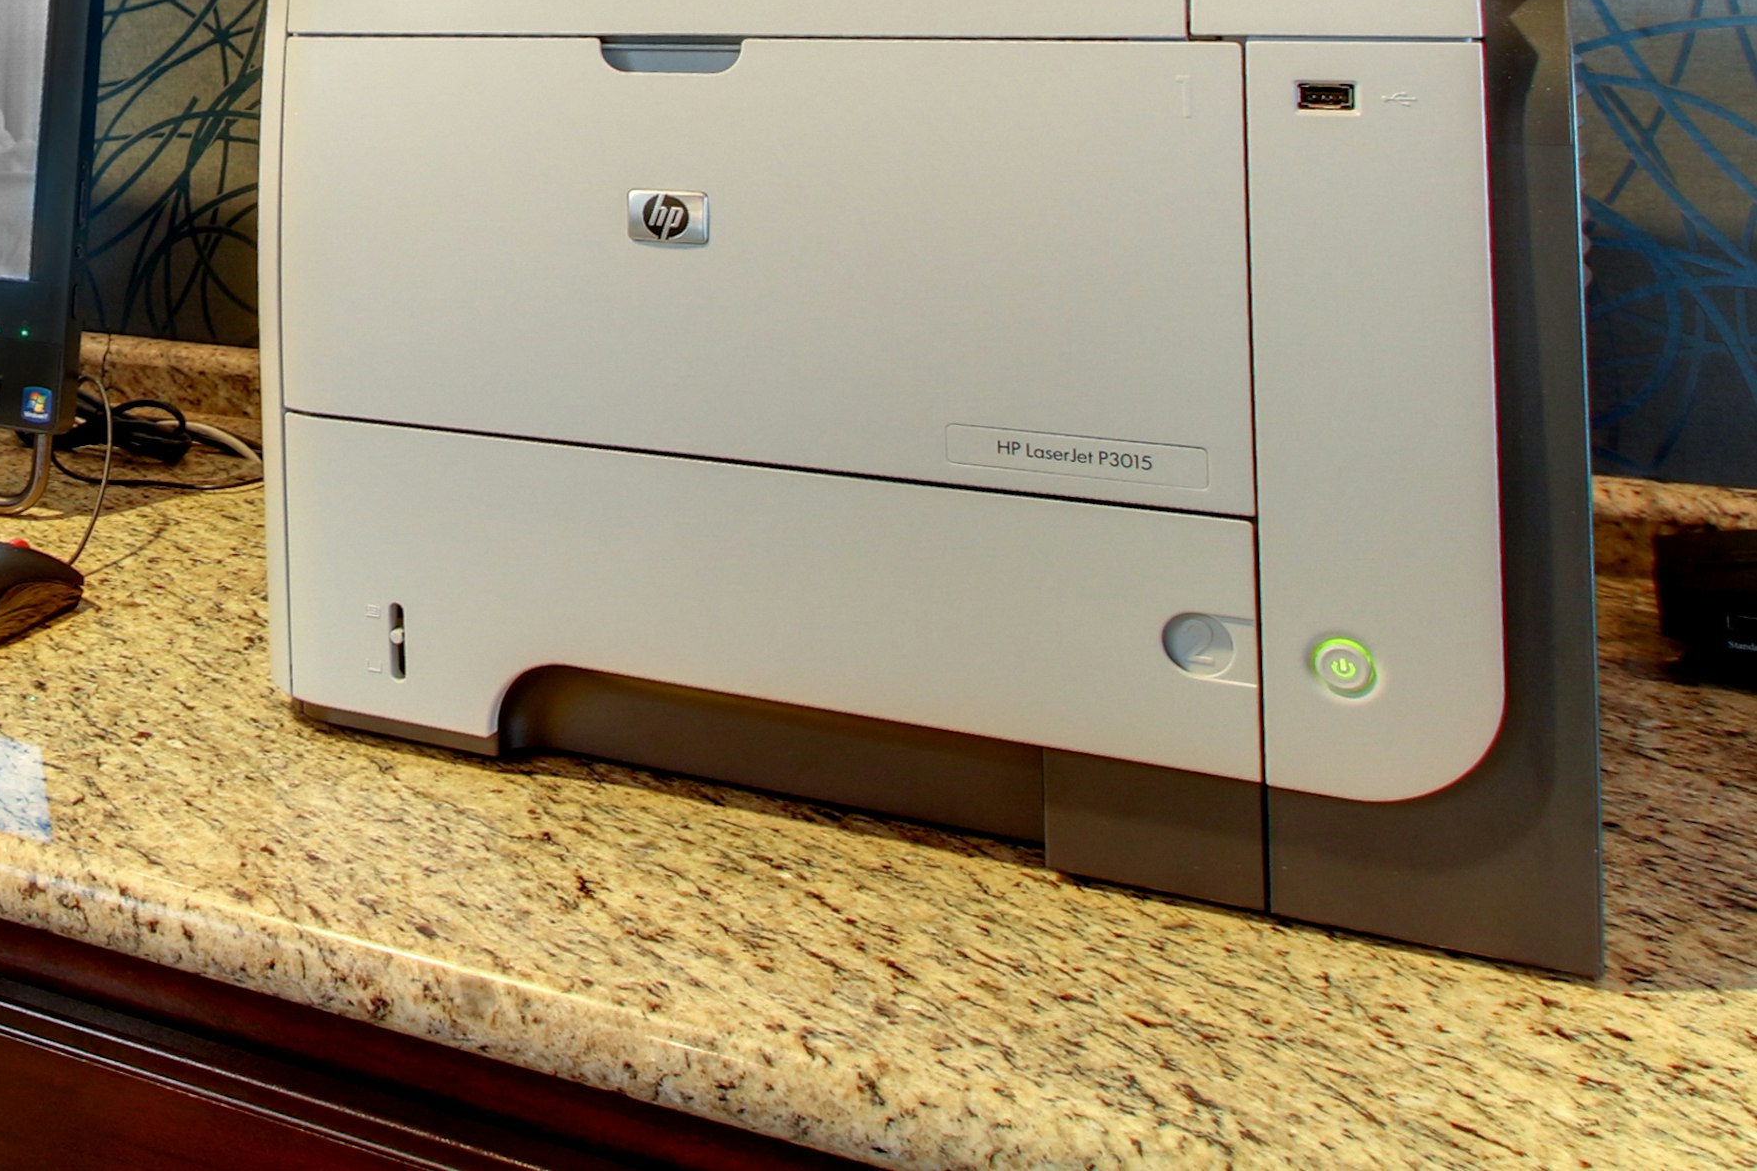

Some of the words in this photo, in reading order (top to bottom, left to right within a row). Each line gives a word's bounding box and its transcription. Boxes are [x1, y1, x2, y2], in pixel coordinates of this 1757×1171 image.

[648, 194, 684, 239] hp
[997, 440, 1021, 456] HP
[1025, 443, 1093, 465] LaserJet
[1098, 450, 1153, 471] P3015
